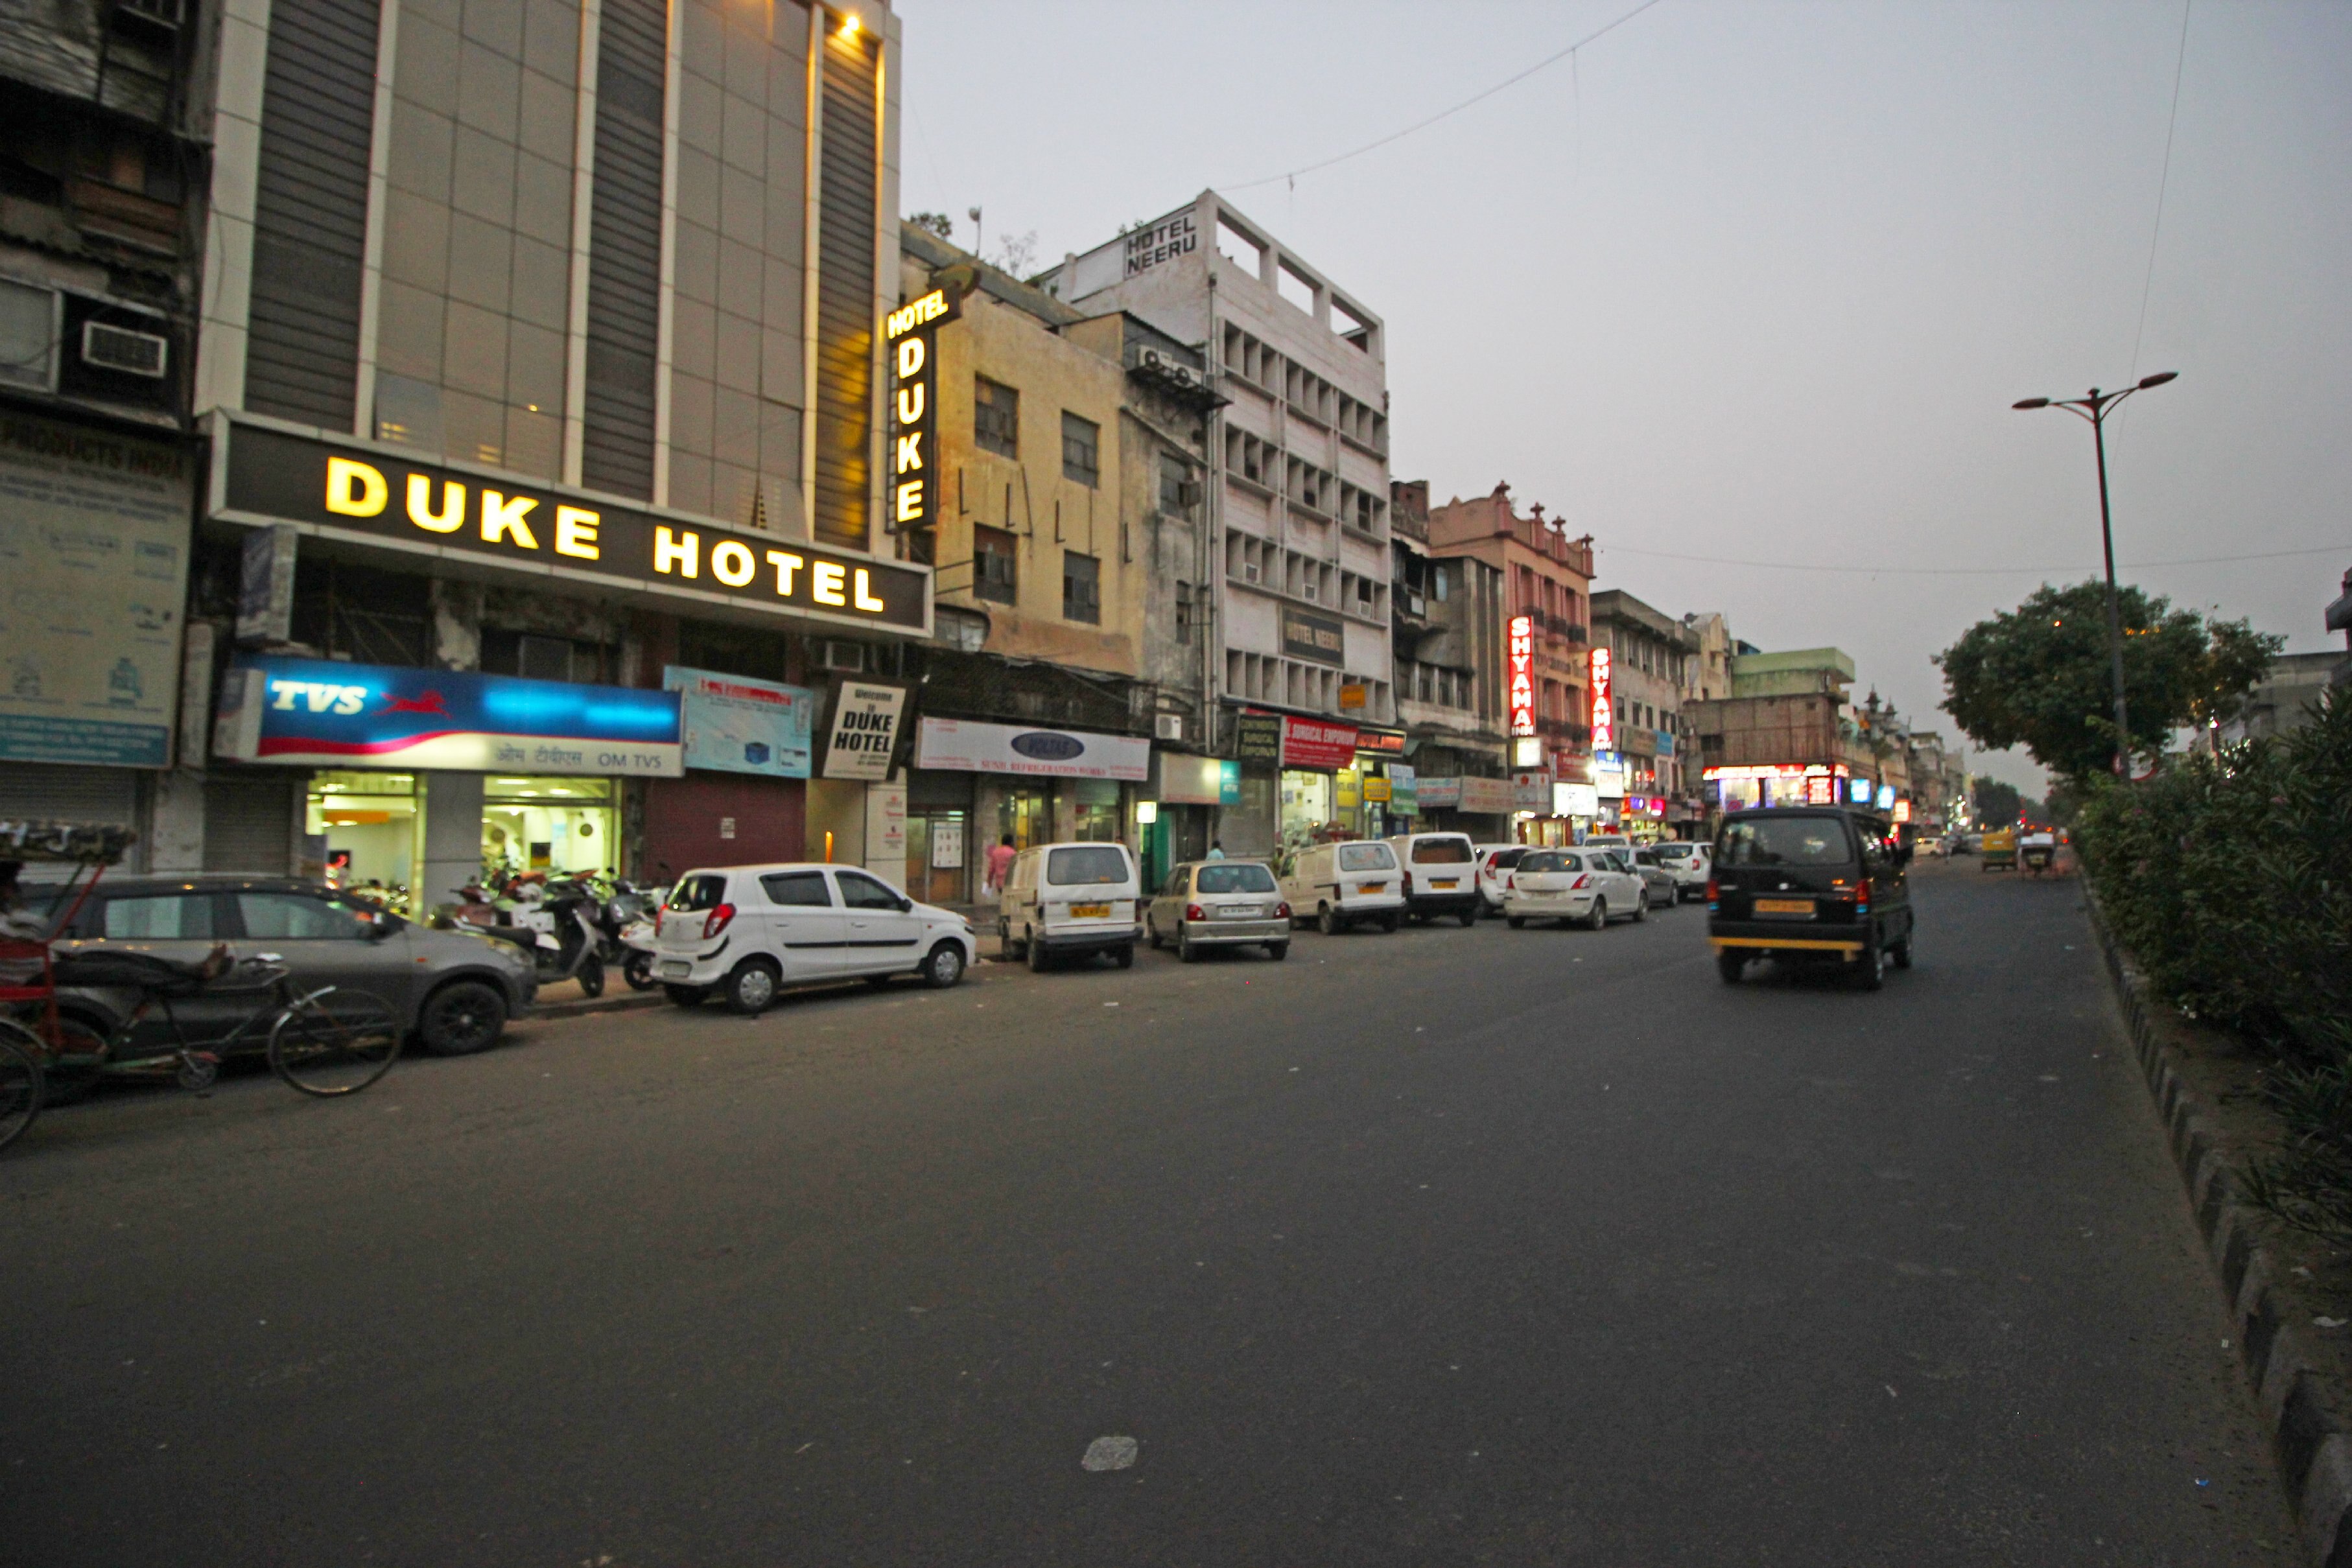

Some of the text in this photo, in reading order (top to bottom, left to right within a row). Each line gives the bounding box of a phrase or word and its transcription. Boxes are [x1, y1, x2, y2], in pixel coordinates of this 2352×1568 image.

[1127, 217, 1196, 254] HOTEL
[1127, 234, 1196, 274] NEERU
[888, 289, 948, 339] HOTEL
[897, 337, 924, 522] DUKE
[325, 456, 884, 612] DUKE HOTEL
[1511, 616, 1531, 725] SHYAMA
[271, 679, 368, 714] TVS
[1592, 648, 1610, 742] SHYAMA
[843, 711, 893, 732] DUKE
[598, 752, 661, 769] OM TVS
[834, 731, 890, 753] HOTEL
